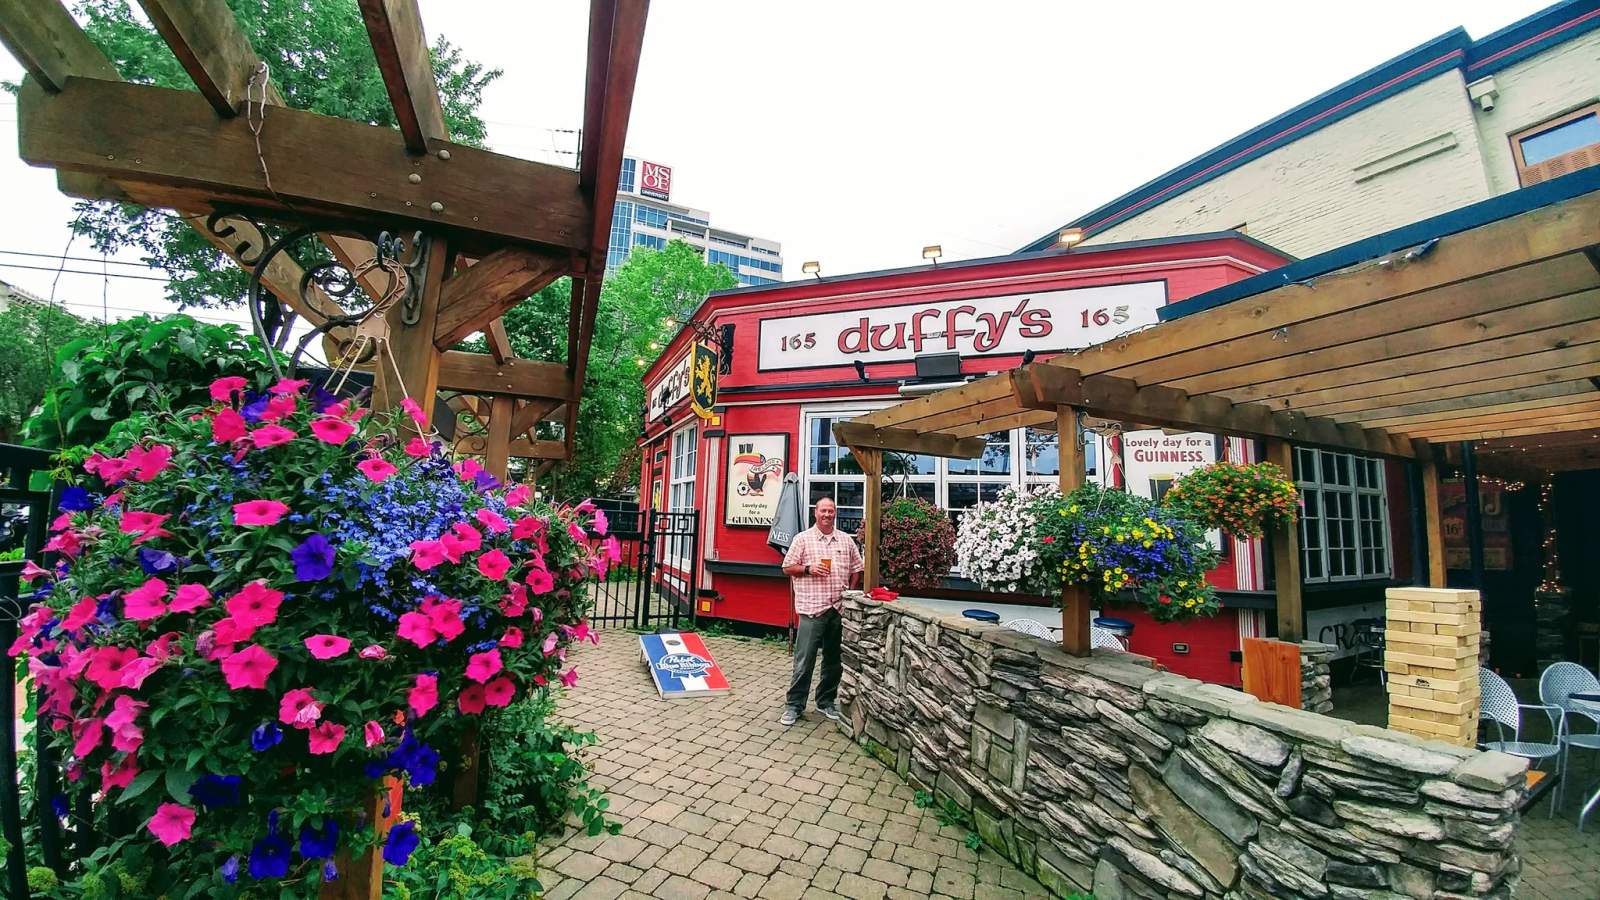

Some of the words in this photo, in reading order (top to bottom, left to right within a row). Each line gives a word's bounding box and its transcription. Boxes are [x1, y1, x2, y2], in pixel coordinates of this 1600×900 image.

[645, 164, 670, 179] MS
[644, 175, 668, 190] OE
[781, 332, 817, 352] 165
[838, 298, 1053, 353] duffy's
[1080, 304, 1130, 328] 165
[658, 359, 690, 409] dffy's
[1125, 438, 1159, 449] Lovely
[1162, 437, 1181, 449] day
[1186, 437, 1201, 446] for
[1204, 439, 1212, 447] a
[732, 516, 774, 525] GUINNES
